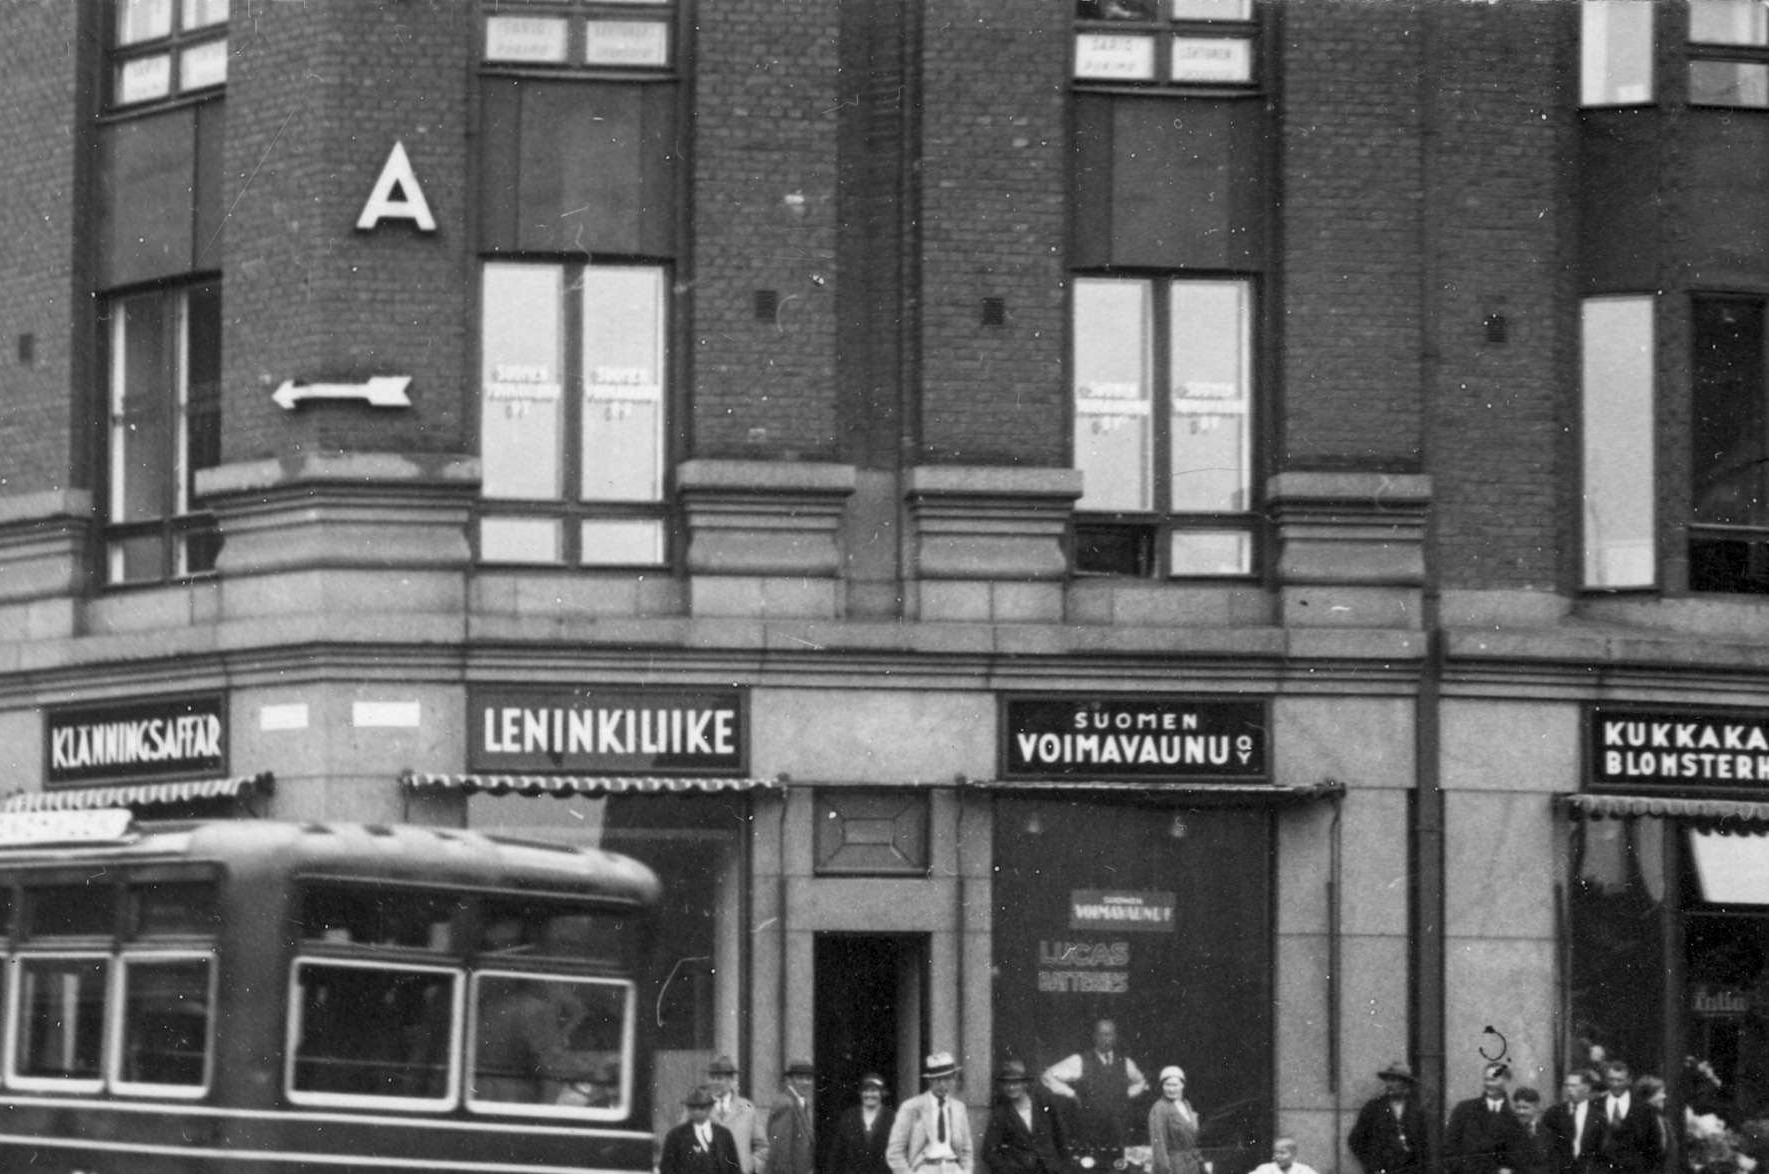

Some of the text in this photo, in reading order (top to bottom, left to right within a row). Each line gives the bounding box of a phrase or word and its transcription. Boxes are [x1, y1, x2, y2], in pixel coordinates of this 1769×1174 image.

[356, 140, 437, 231] A
[1074, 711, 1198, 730] SUOMEN
[52, 713, 222, 769] KLÄNNINGSAFFÄR
[1017, 733, 1229, 765] VOIMAVAUNU
[1039, 940, 1130, 967] LUCAS
